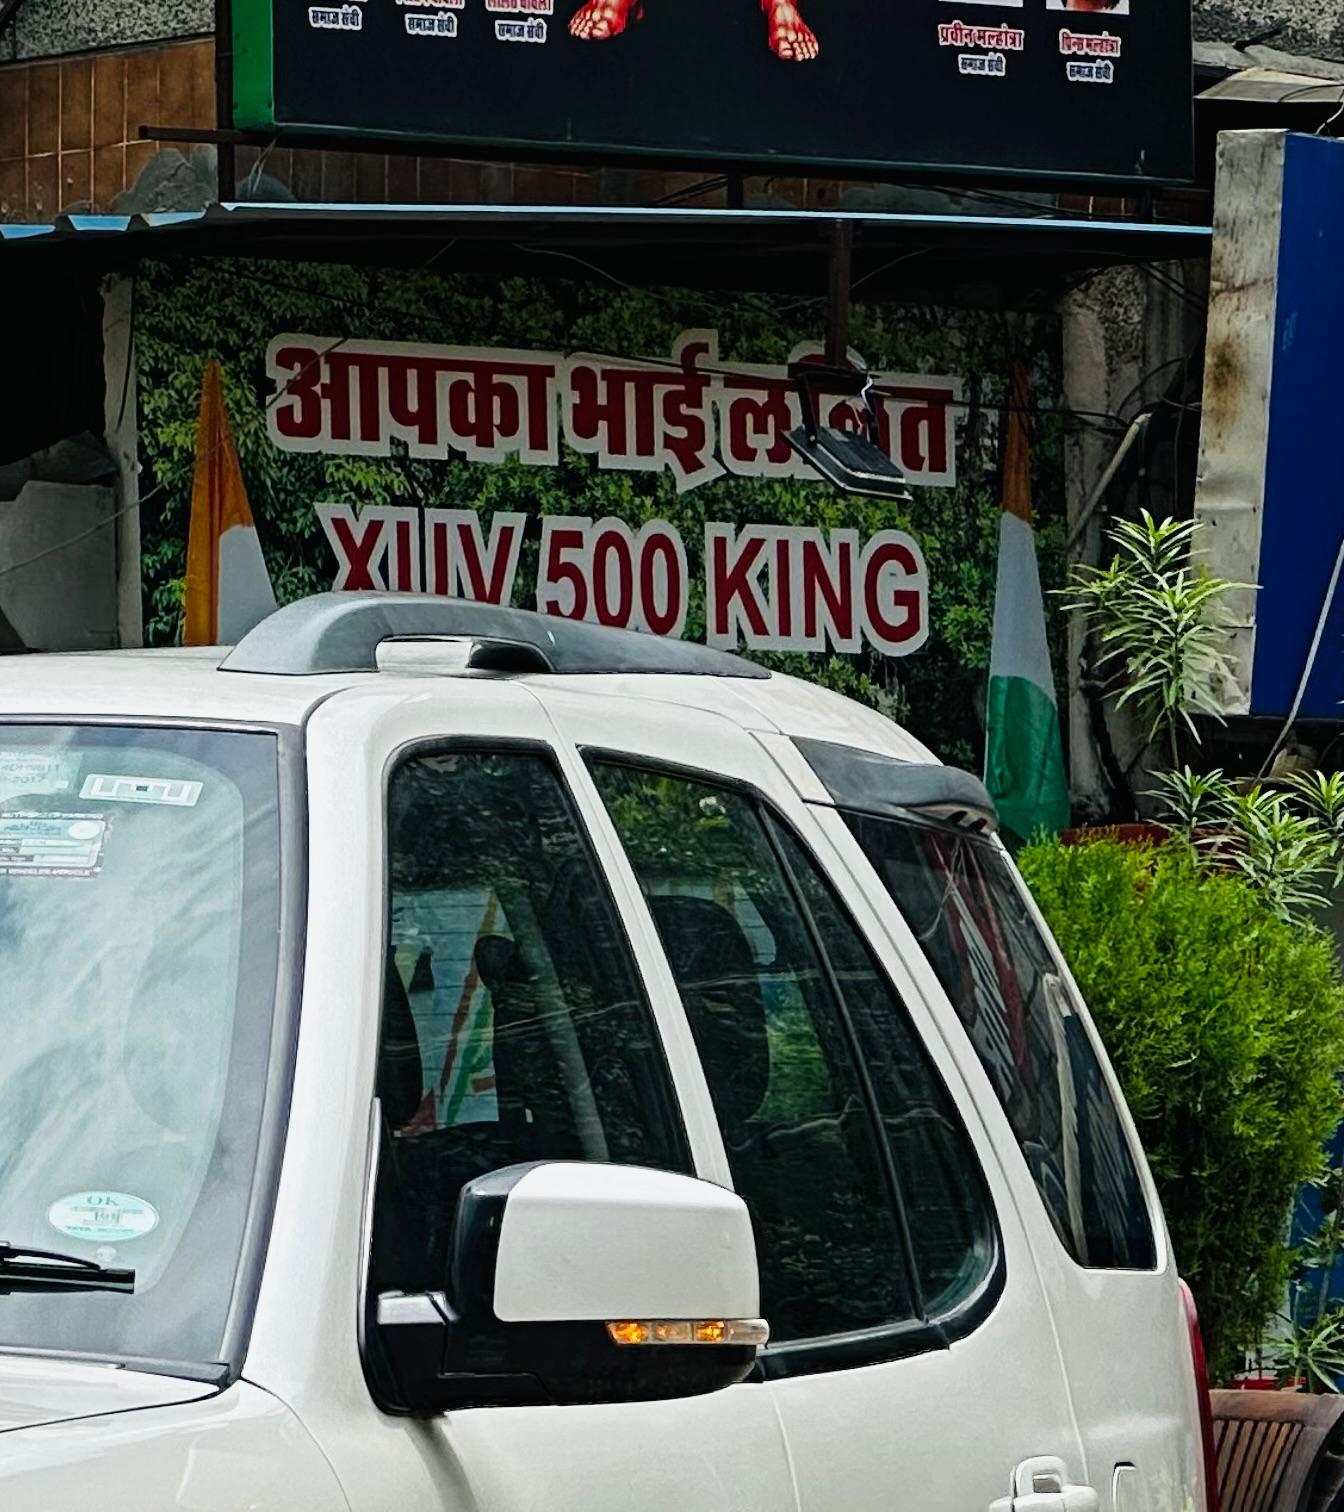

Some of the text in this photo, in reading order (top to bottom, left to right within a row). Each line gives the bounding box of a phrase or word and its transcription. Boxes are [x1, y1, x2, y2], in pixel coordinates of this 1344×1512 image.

[274, 346, 556, 452] आपका
[570, 342, 711, 475] भाई
[546, 529, 681, 636] 500
[714, 536, 921, 644] KING
